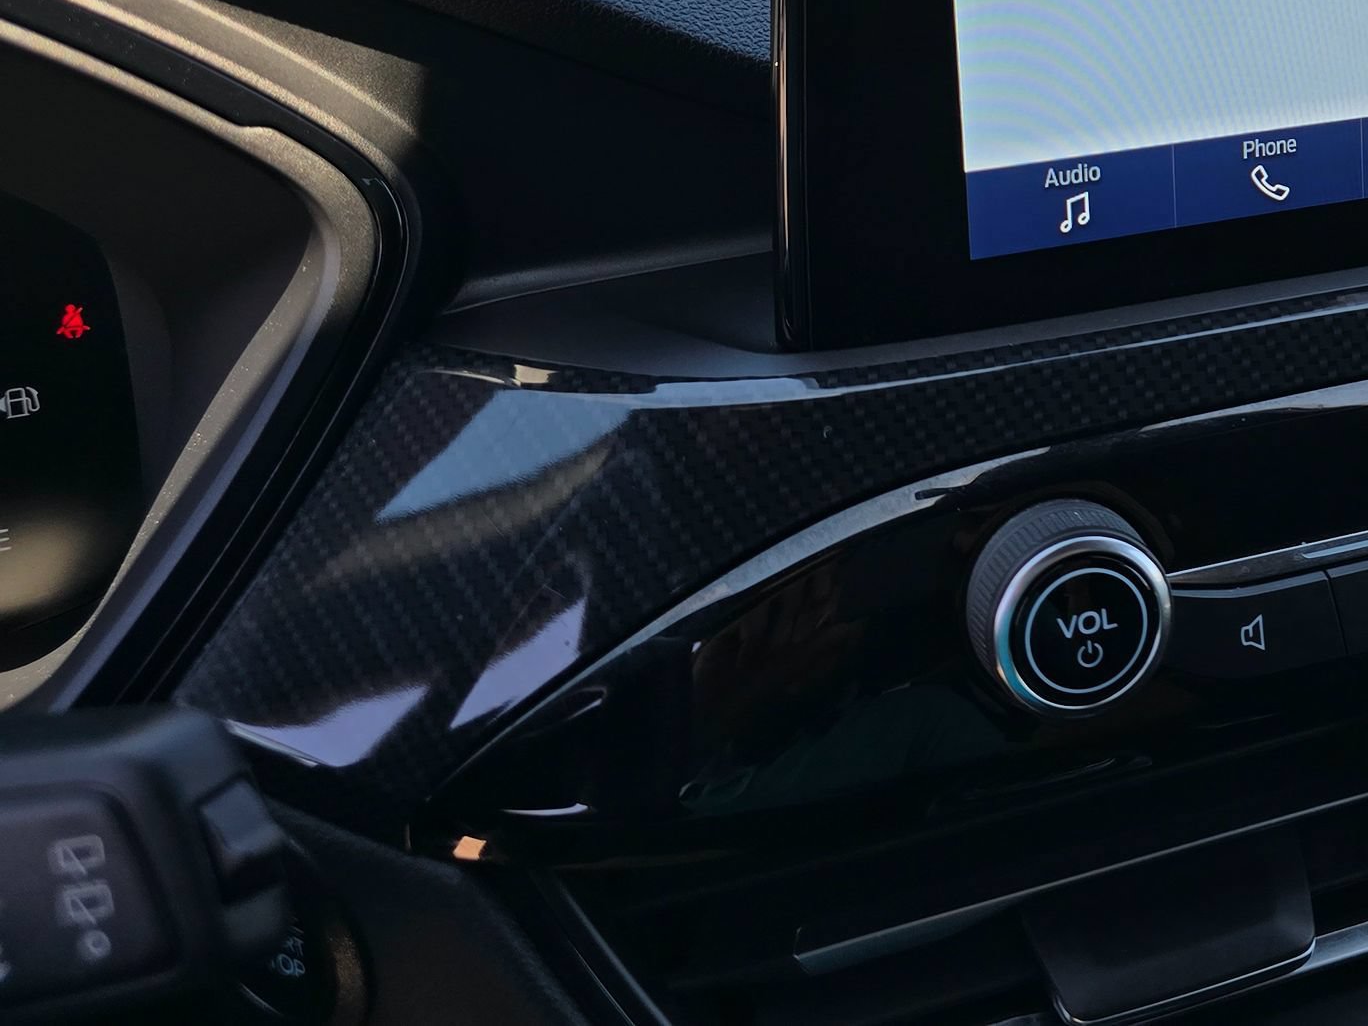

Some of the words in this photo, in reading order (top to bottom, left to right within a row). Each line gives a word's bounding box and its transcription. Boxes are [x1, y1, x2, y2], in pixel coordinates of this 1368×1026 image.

[1242, 135, 1298, 160] Phone
[1044, 163, 1102, 188] Audio
[1056, 607, 1119, 639] VOL
